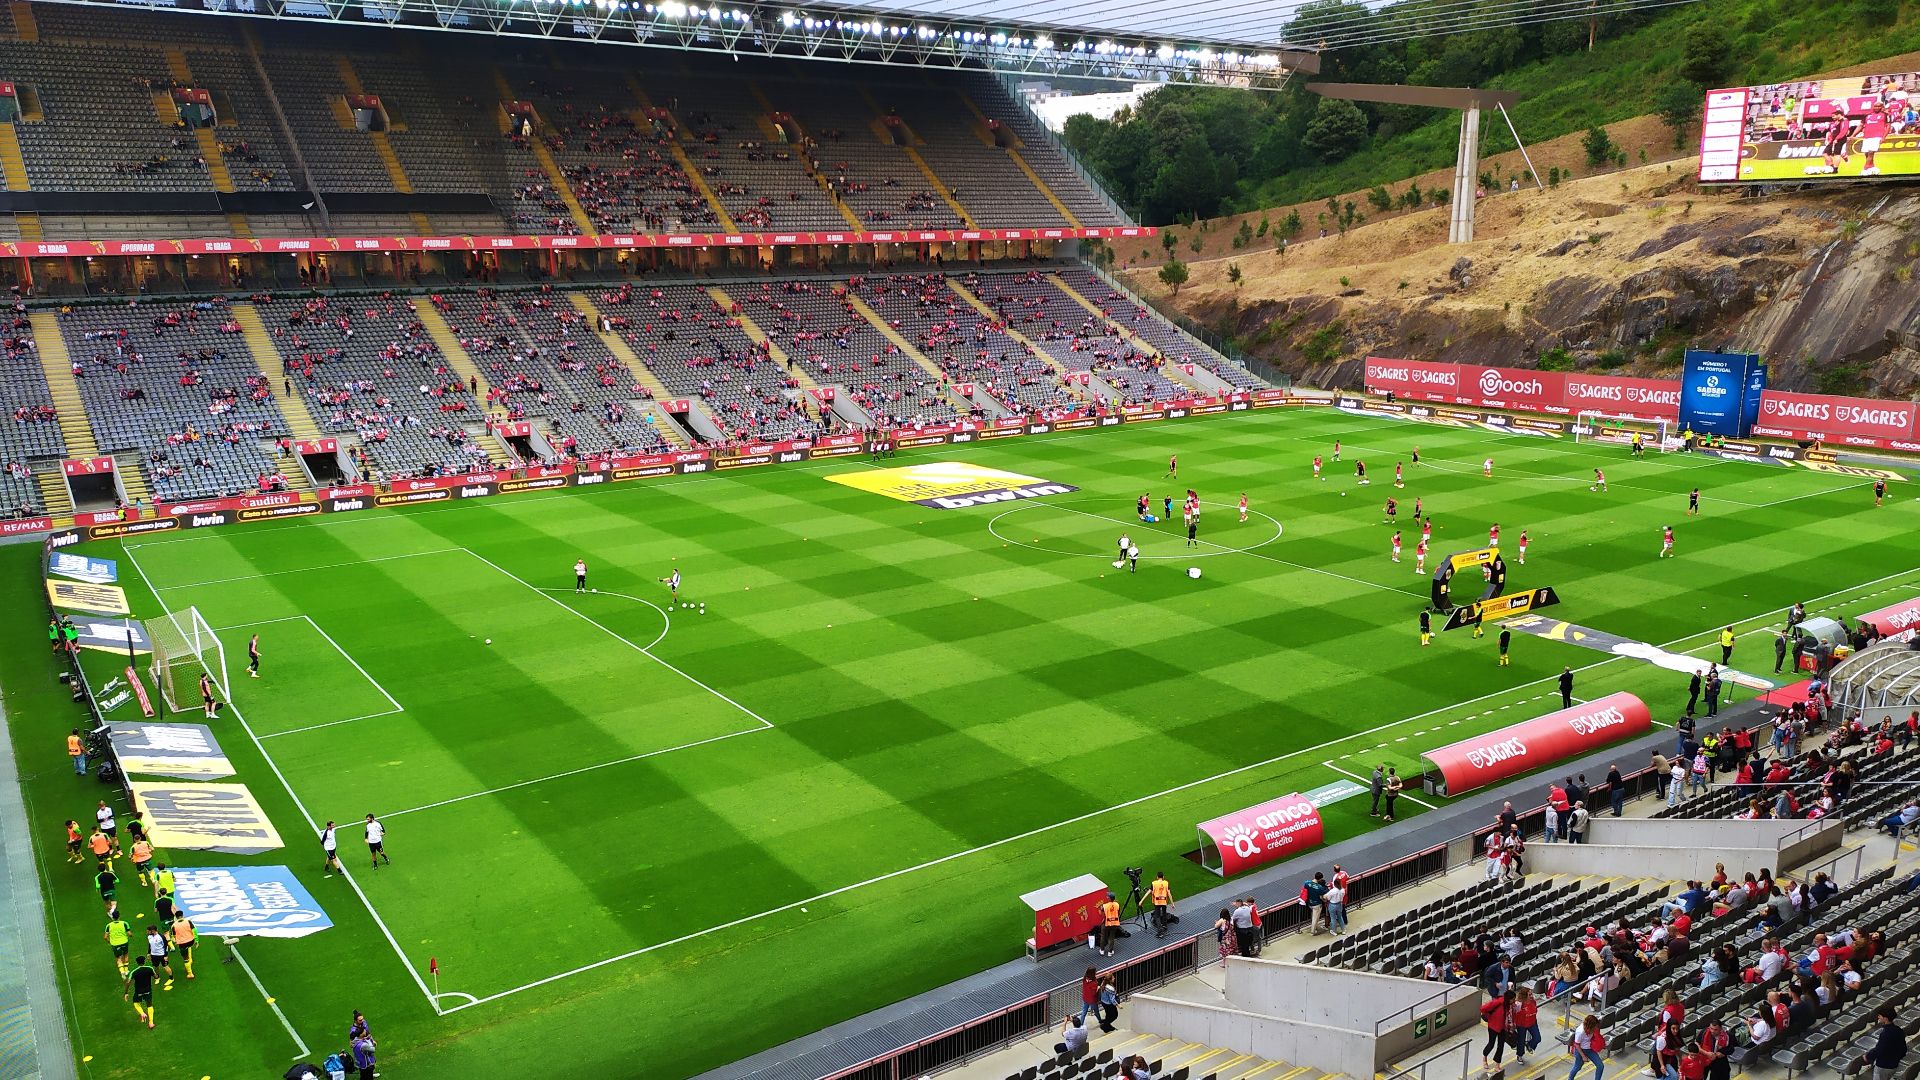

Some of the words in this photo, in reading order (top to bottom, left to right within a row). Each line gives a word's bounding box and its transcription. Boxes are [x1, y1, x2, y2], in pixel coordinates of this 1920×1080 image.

[1778, 142, 1826, 159] bwi
[38, 245, 47, 254] SC
[48, 245, 68, 254] BRAGA
[1377, 366, 1409, 382] SAGRES
[1421, 370, 1456, 386] SAGRES
[1579, 383, 1622, 402] SAGRES
[1638, 387, 1681, 406] SAGRES
[1169, 409, 1185, 418] bwin
[1411, 407, 1429, 417] bwin
[1777, 400, 1830, 421] SAGRES
[1850, 406, 1908, 428] SAGRES
[1102, 416, 1119, 426] bwin
[1486, 415, 1506, 426] bwin
[1031, 424, 1049, 434] bwin
[953, 432, 971, 442] bwin
[1740, 444, 1756, 452] jogo
[1769, 447, 1795, 459] bwin
[756, 455, 769, 463] jogo
[780, 451, 801, 462] bwin
[639, 467, 657, 475] nosso
[656, 466, 671, 475] jogo
[683, 461, 706, 473] bwin
[528, 479, 548, 487] nosso
[548, 478, 563, 487] jogo
[577, 472, 604, 485] bwin
[429, 490, 446, 500] jogo
[461, 484, 489, 498] bwin
[934, 484, 1068, 509] bwin
[249, 494, 290, 507] auditiv
[333, 497, 363, 512] bwin
[274, 506, 297, 514] nosso
[297, 503, 316, 514] jogo
[192, 512, 225, 527] bwin
[4, 521, 45, 533] RE/MAX
[95, 528, 114, 536] Este
[129, 523, 152, 532] nosso
[152, 519, 173, 530] jogo
[1511, 597, 1528, 608] bwin
[1583, 705, 1625, 734] SAGRES
[1480, 736, 1527, 767] SAGRES
[1255, 802, 1313, 831] amco
[1264, 815, 1319, 842] intermediários
[1267, 835, 1294, 851] crédito
